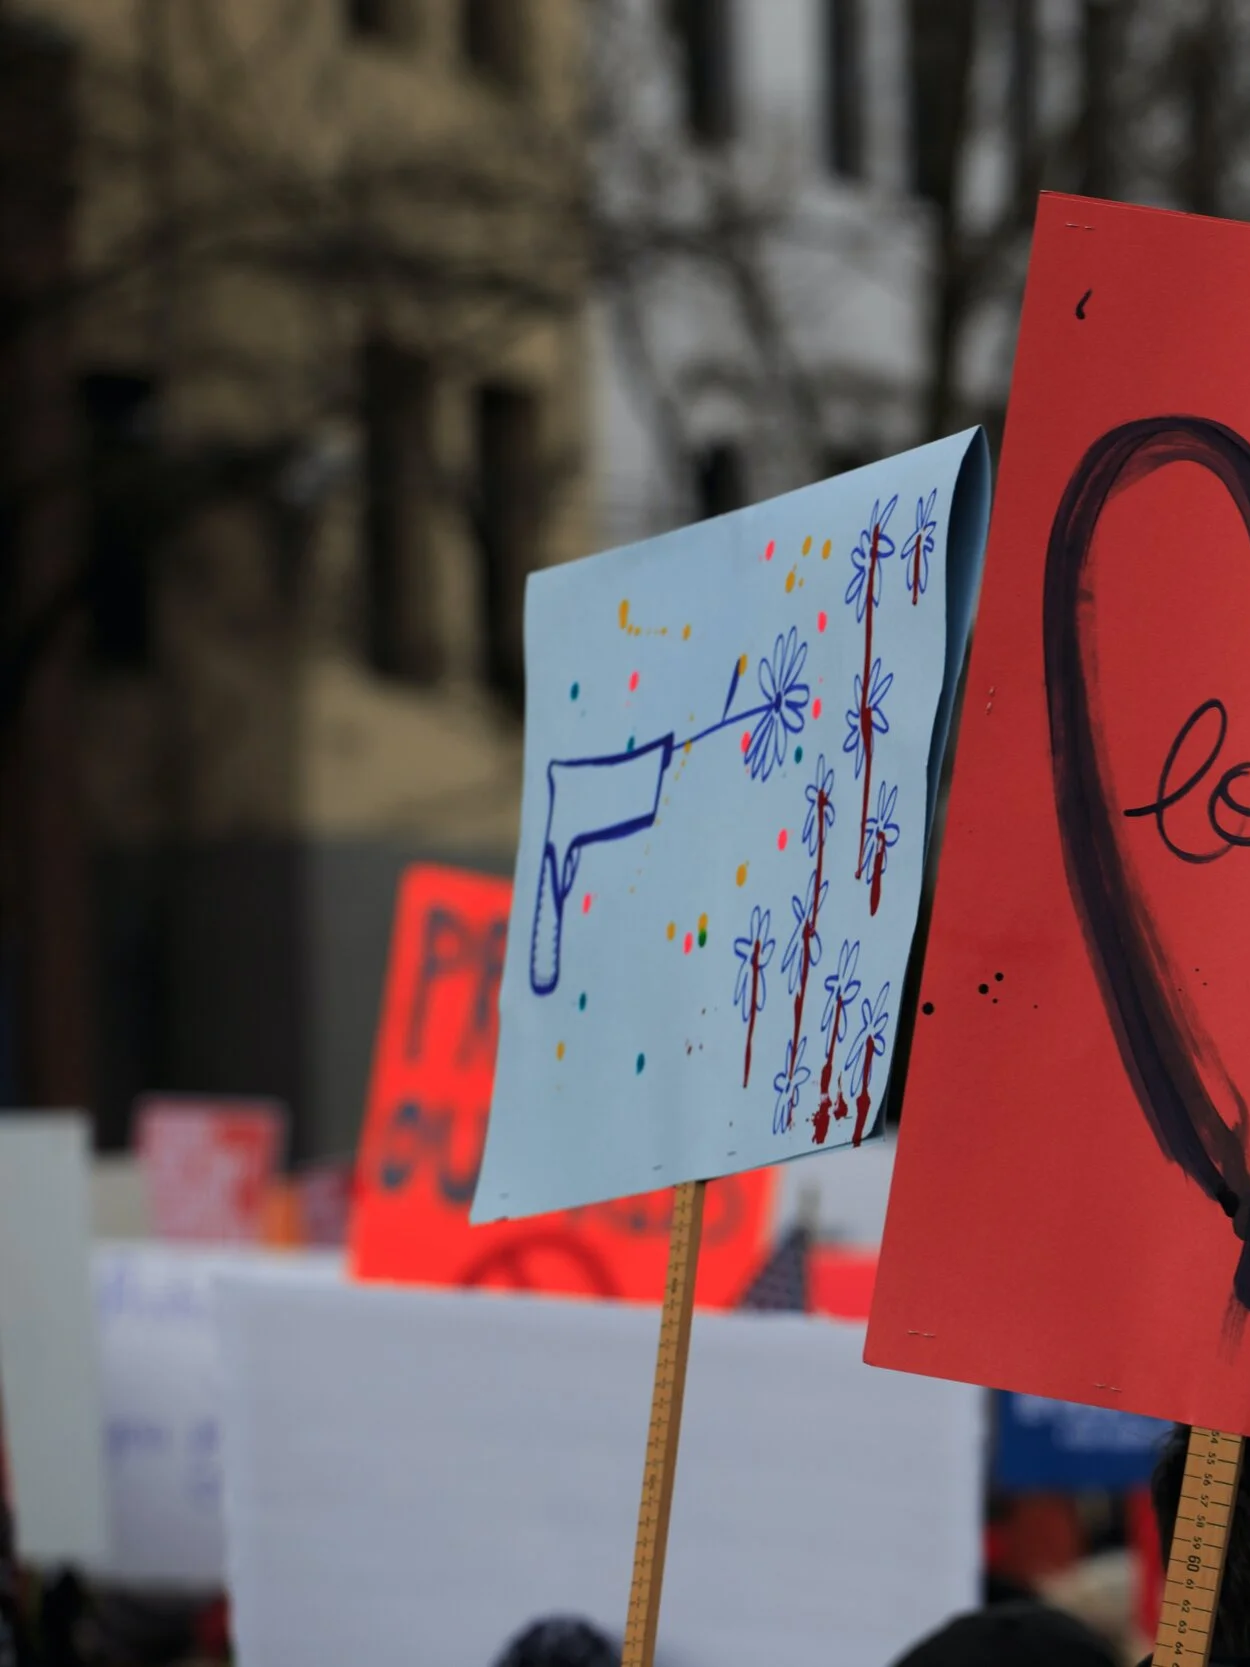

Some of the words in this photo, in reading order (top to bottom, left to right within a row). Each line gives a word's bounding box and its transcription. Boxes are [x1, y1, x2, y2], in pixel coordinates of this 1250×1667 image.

[1210, 1430, 1220, 1445] 54
[1206, 1451, 1217, 1466] 55
[1202, 1473, 1213, 1487] 56
[1200, 1494, 1209, 1509] 57
[1195, 1514, 1206, 1529] 58
[1193, 1535, 1202, 1550] 59
[1186, 1555, 1202, 1573] 60
[1185, 1578, 1195, 1590] 61
[1181, 1599, 1191, 1614] 62
[1177, 1620, 1187, 1635] 63
[1174, 1641, 1184, 1656] 64
